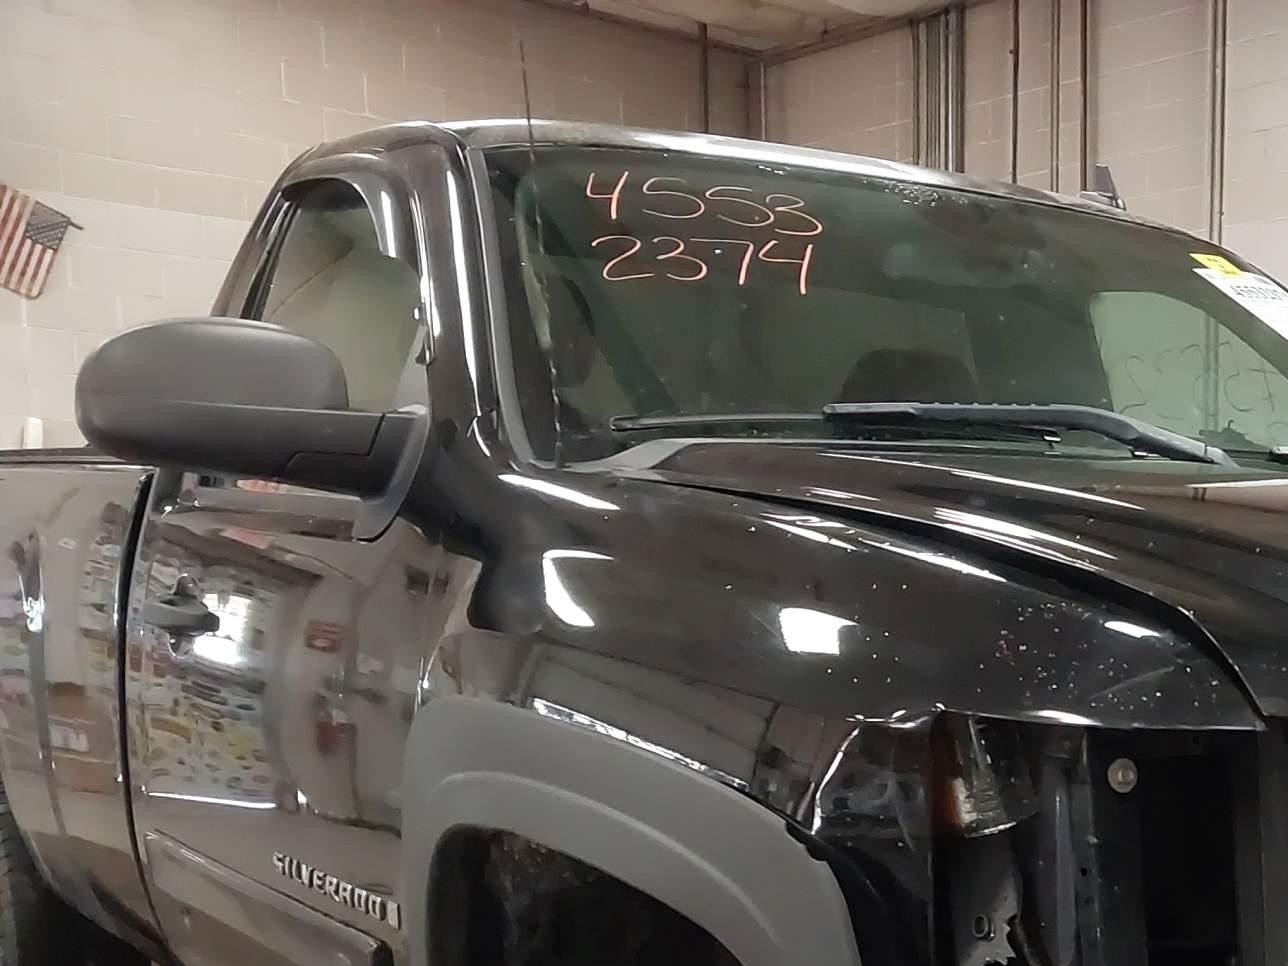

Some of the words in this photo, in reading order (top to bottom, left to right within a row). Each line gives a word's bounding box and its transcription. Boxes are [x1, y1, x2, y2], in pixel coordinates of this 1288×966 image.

[586, 171, 823, 235] 4553
[591, 235, 814, 295] 2374
[272, 851, 383, 921] SILVERADO
